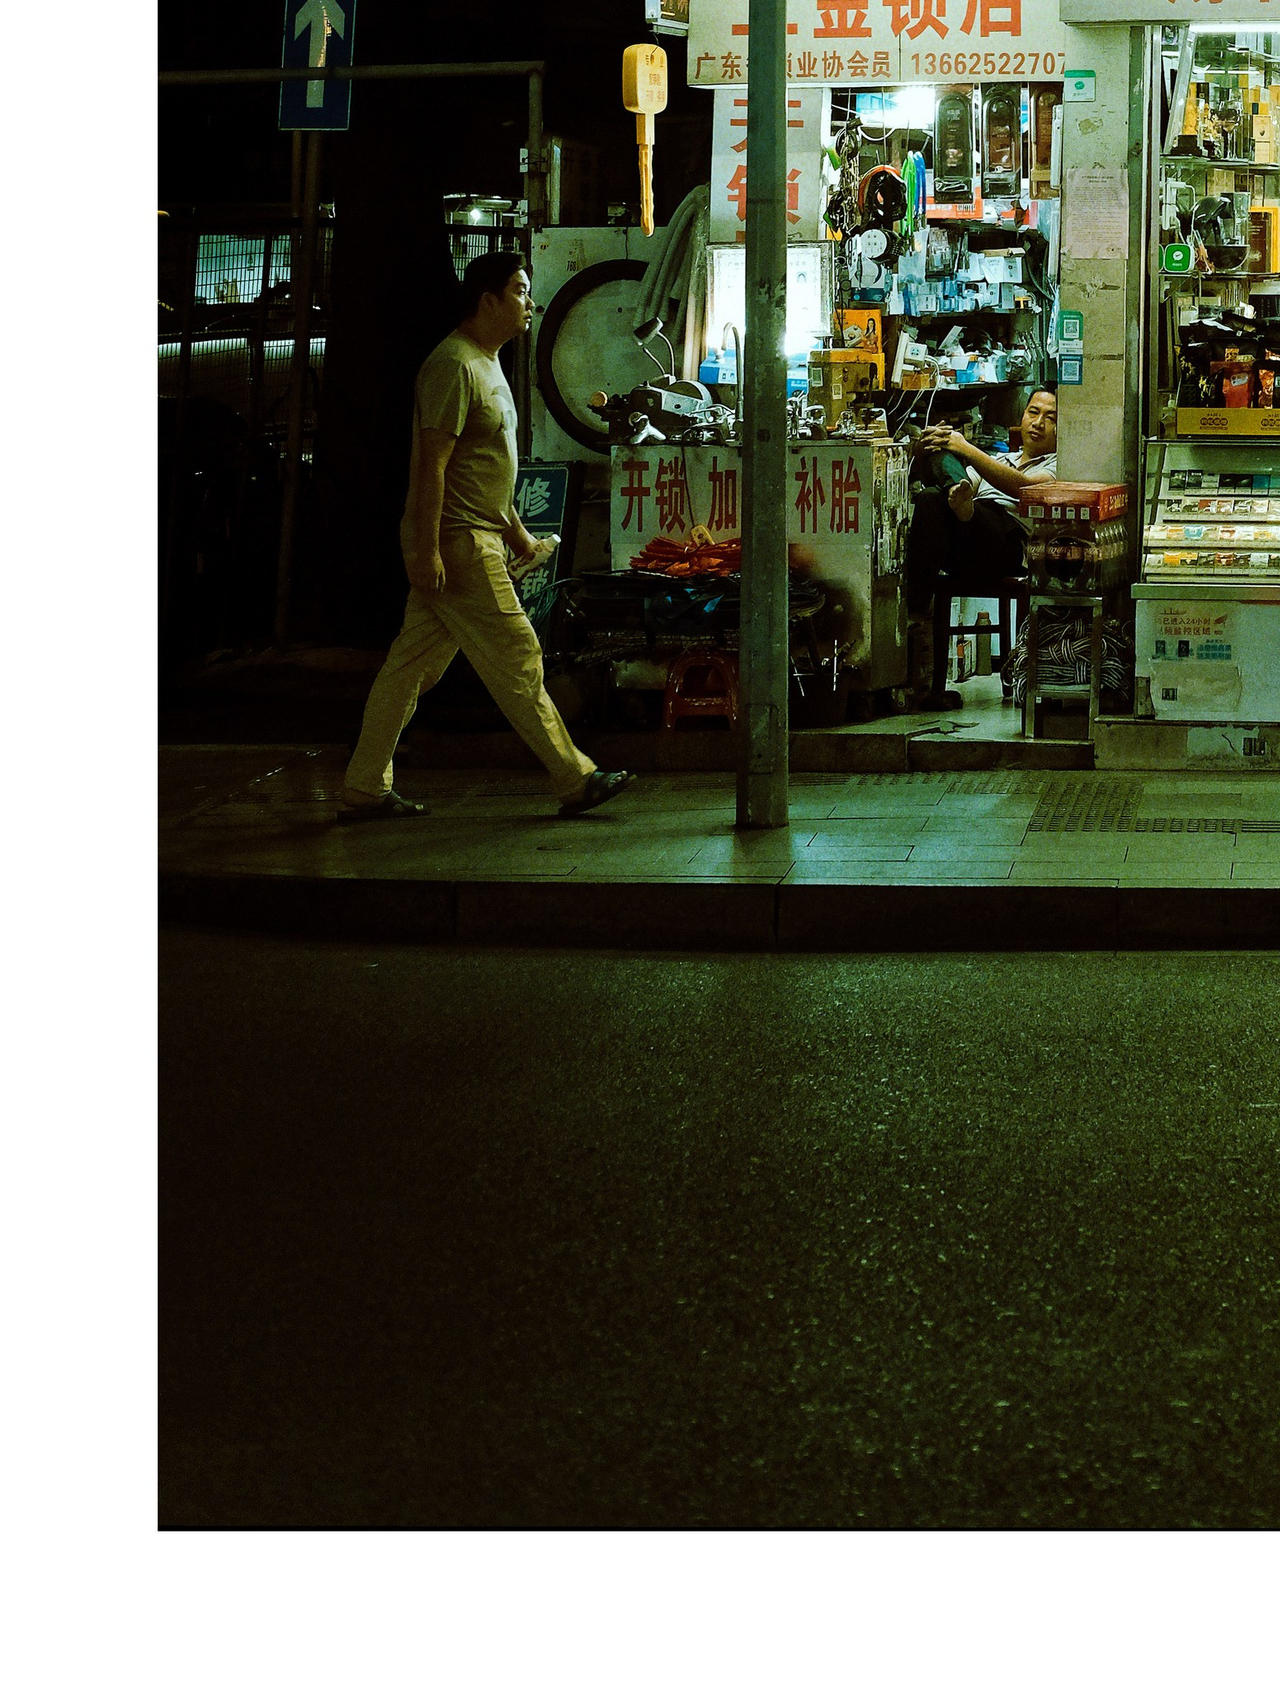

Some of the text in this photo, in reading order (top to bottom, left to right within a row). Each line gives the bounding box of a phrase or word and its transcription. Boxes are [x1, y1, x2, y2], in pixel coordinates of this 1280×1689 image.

[694, 50, 892, 79] 广东业协会员
[620, 456, 687, 532] 开锁
[795, 455, 862, 534] 补胎
